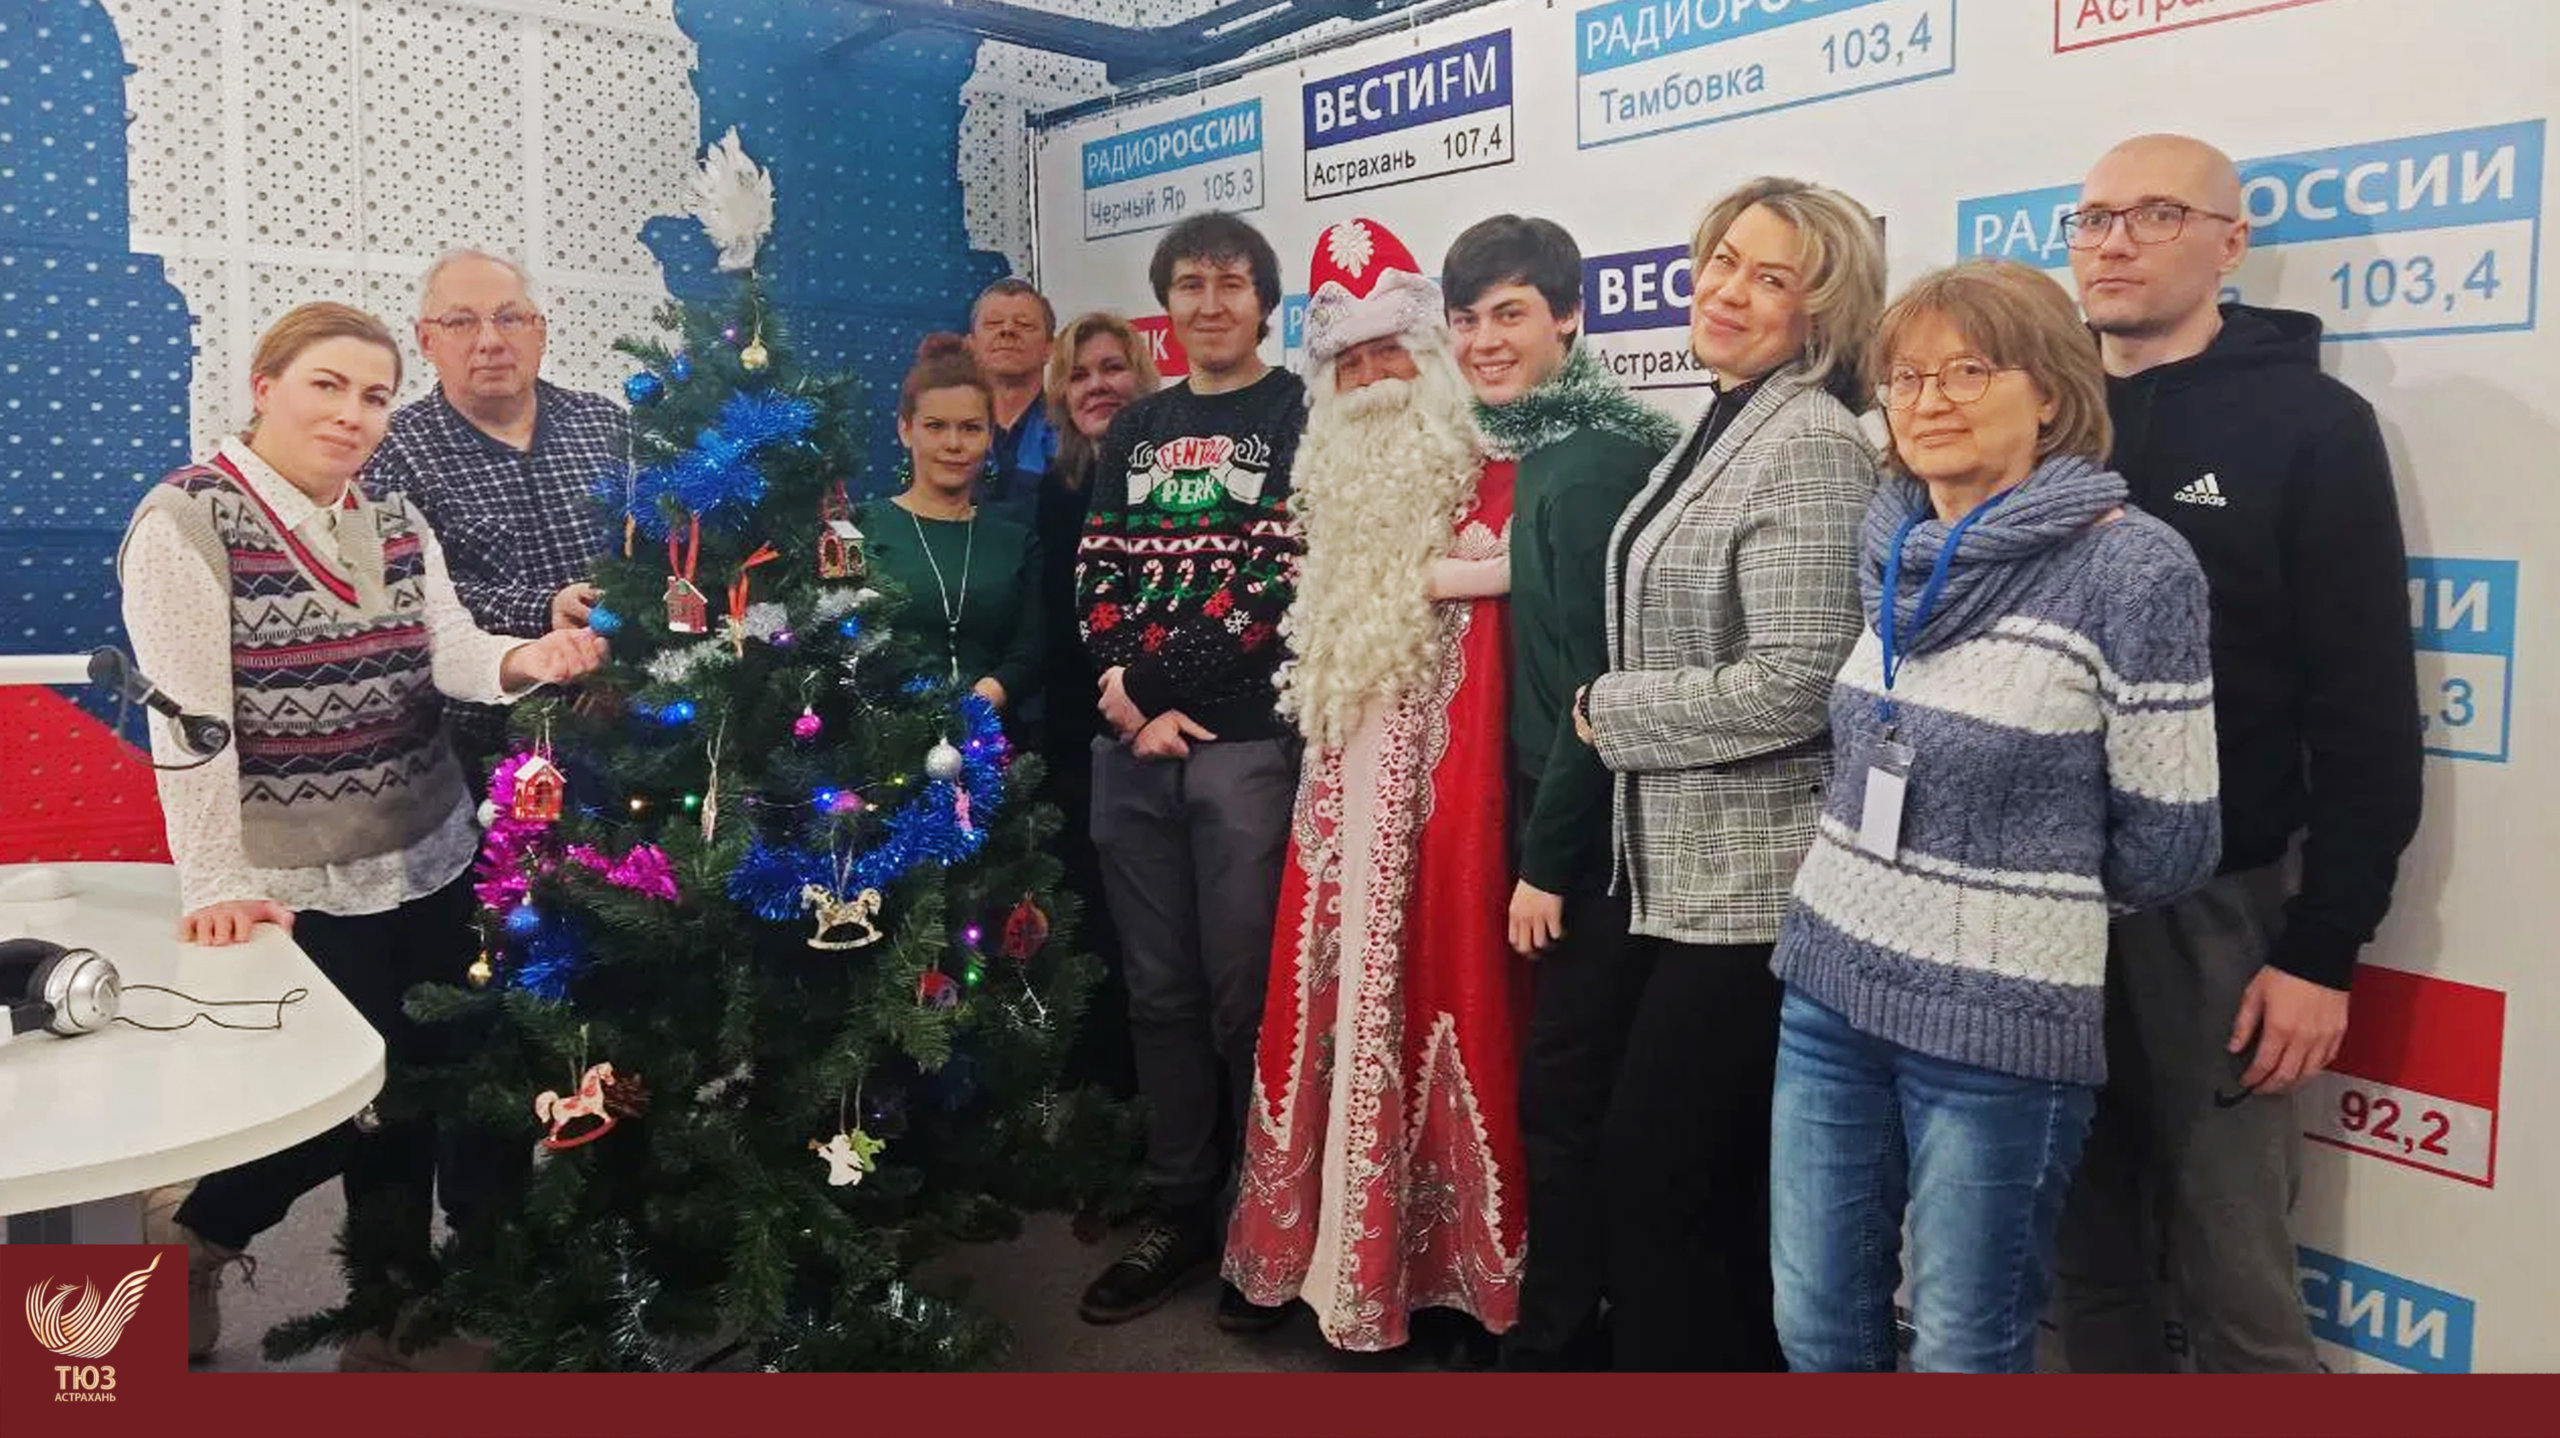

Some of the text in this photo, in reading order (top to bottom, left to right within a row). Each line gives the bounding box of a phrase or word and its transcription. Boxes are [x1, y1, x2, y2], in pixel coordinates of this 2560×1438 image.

[1599, 12, 1932, 123] Тамбовка 103,4
[1087, 110, 1256, 176] РАДИОРОССИИ
[1312, 123, 1502, 187] Астрахань 107,4
[1091, 168, 1253, 227] Черный Яр 105,3
[2330, 249, 2501, 312] 103,4
[1159, 438, 1230, 473] CENTRAL
[1161, 475, 1217, 505] PERK
[2174, 491, 2228, 507] adidas
[2340, 1089, 2451, 1156] 92,2
